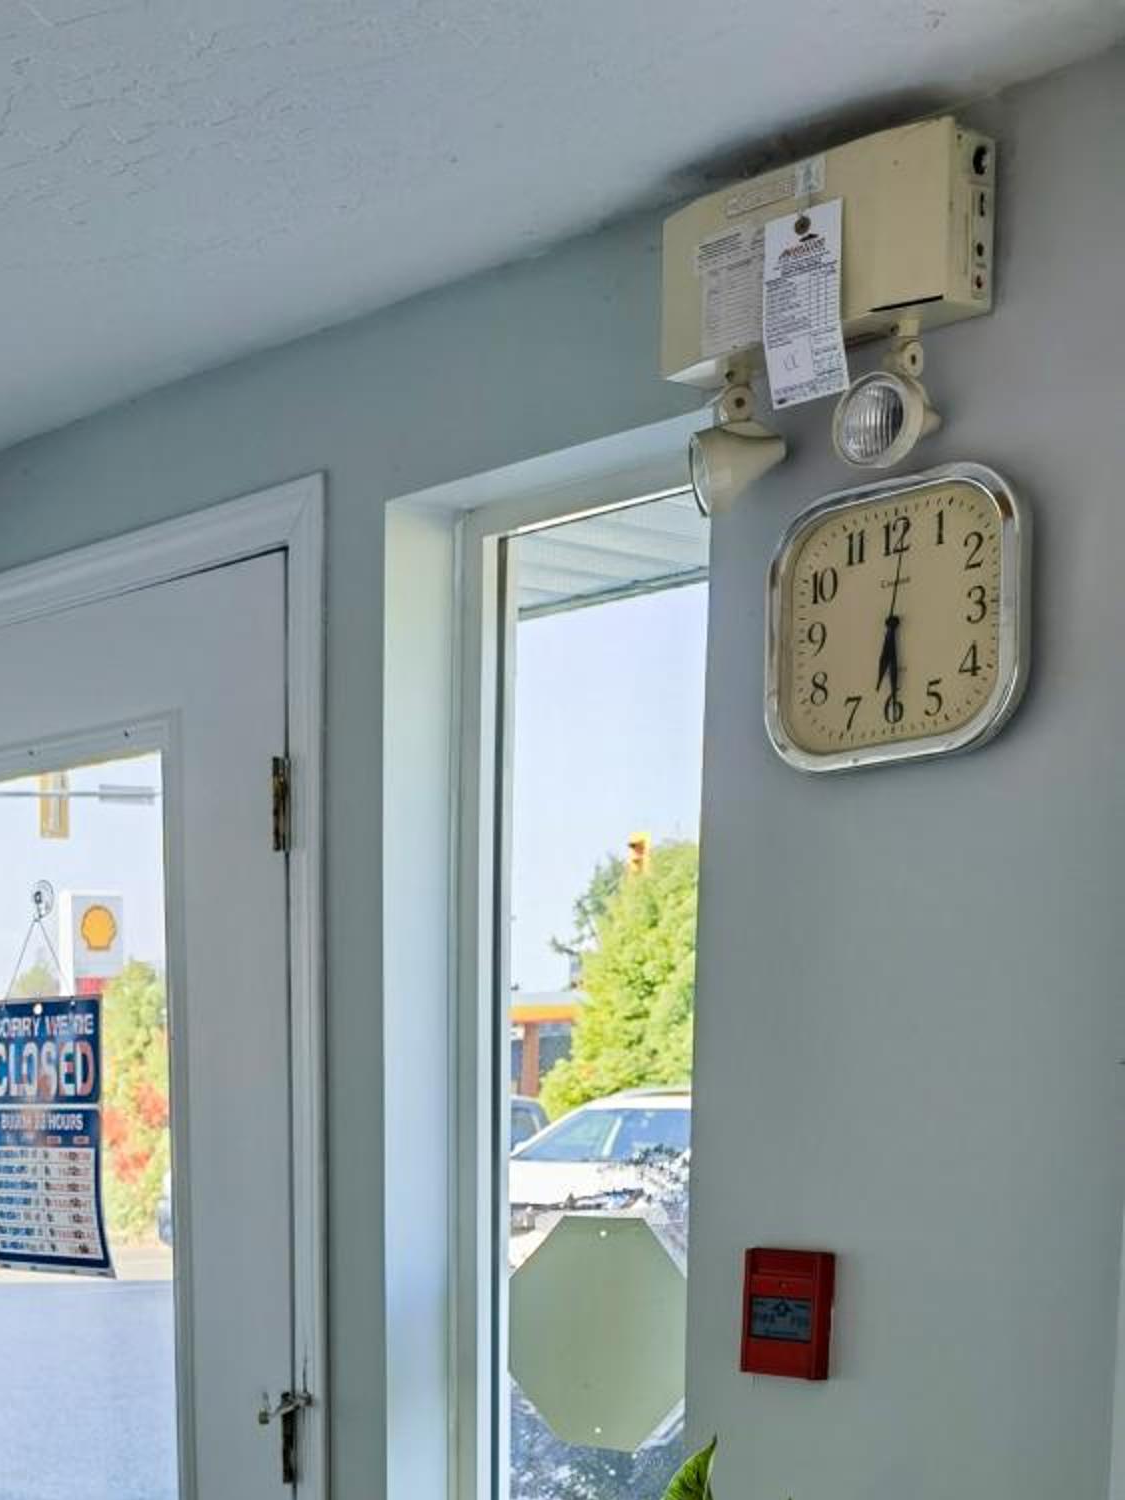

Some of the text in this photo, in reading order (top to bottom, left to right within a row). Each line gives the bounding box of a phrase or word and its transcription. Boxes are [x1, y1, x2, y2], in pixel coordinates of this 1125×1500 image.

[882, 515, 911, 557] 12
[934, 509, 946, 545] 1
[845, 529, 866, 567] 11
[963, 531, 985, 571] 2
[811, 566, 839, 605] 10
[966, 585, 987, 624] 3
[807, 621, 827, 656] 9
[958, 643, 982, 677] 4
[810, 671, 829, 706] 8
[884, 687, 904, 724] 6
[924, 677, 944, 717] 5
[843, 695, 863, 731] 7
[48, 1113, 84, 1131] HOURS
